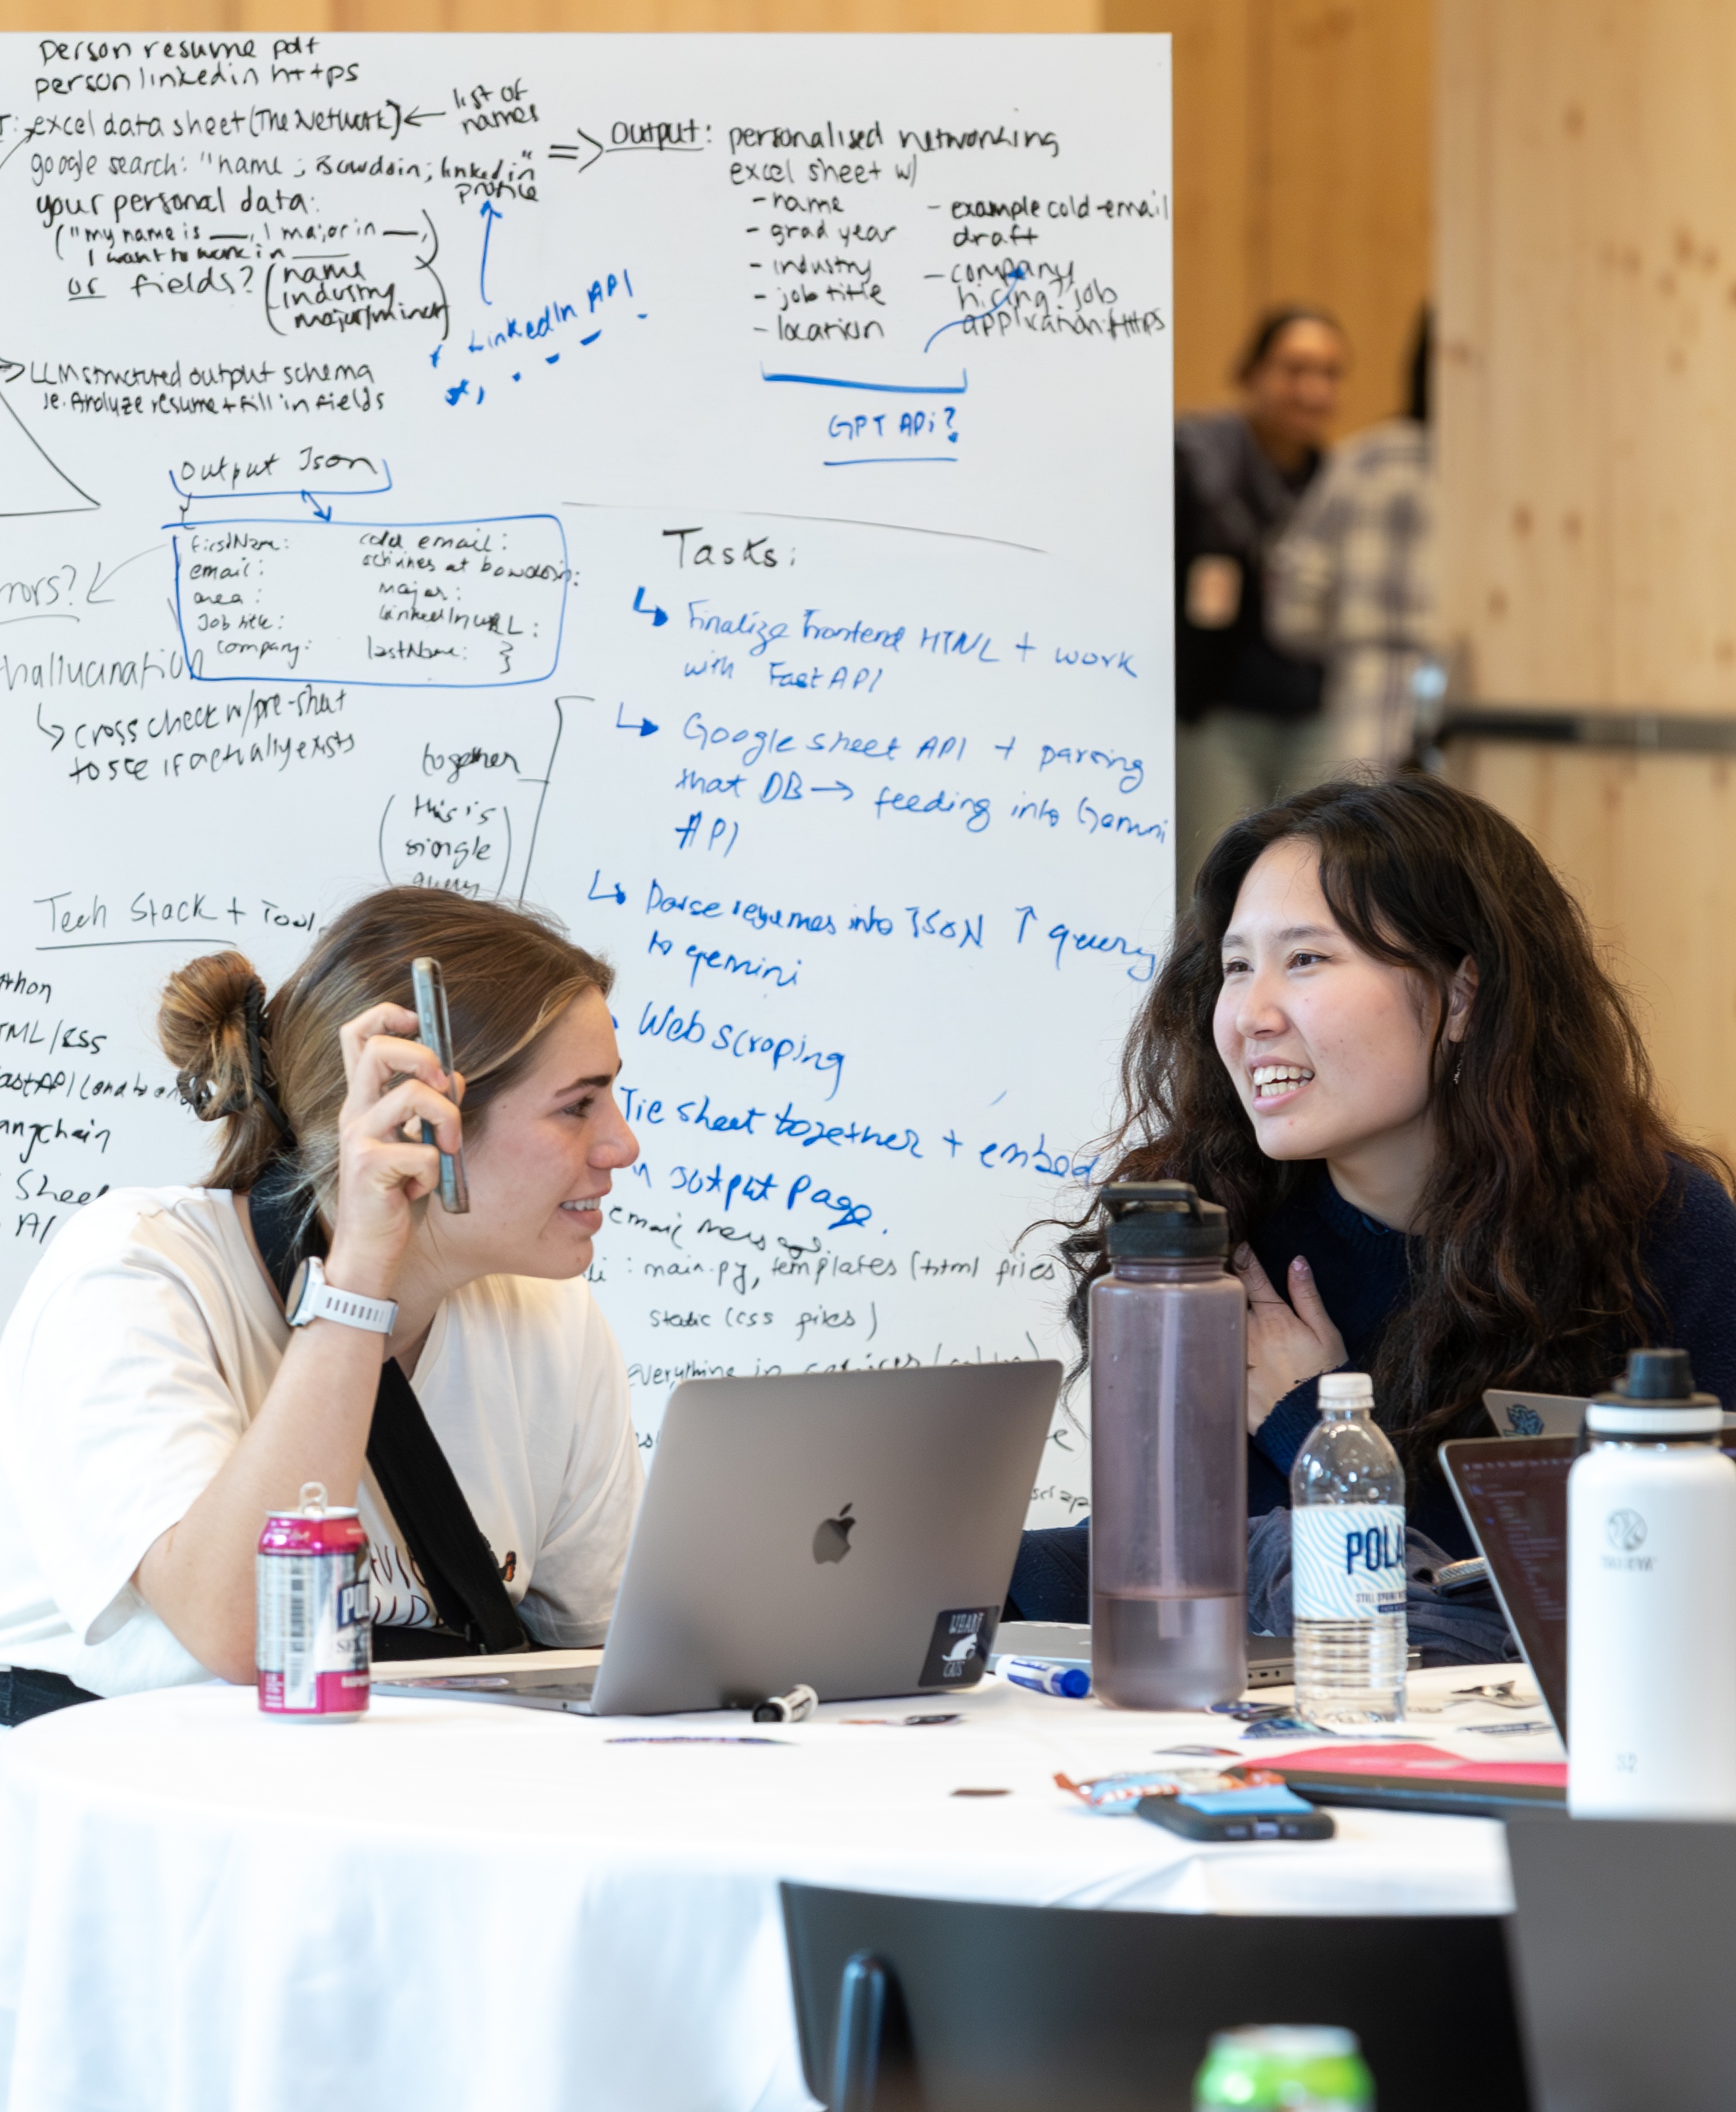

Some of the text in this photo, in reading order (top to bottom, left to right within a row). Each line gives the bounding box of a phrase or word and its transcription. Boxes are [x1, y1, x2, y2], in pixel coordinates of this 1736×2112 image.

[144, 38, 256, 59] resume
[35, 72, 131, 101] person
[453, 77, 529, 110] list of
[33, 109, 95, 136] excel
[462, 104, 540, 135] names
[611, 118, 1059, 158] Output: personalised networking
[31, 150, 97, 187] google
[108, 146, 188, 178] search:
[730, 159, 795, 185] excel
[809, 158, 883, 183] sheet
[37, 185, 320, 229] your personal data:
[773, 192, 845, 214] name
[950, 196, 1040, 222] example
[123, 218, 377, 244] name is major in
[771, 220, 898, 247] grad year
[953, 225, 1039, 248] draft
[106, 249, 168, 265] want
[171, 248, 189, 263] to
[197, 244, 251, 262] work
[256, 244, 285, 260] in
[773, 254, 872, 284] industry
[68, 265, 255, 298] or fields?
[779, 284, 888, 312] job title
[776, 315, 885, 342] location
[189, 361, 276, 390] output
[283, 361, 375, 385] schema
[151, 393, 219, 415] resume
[240, 391, 273, 413] fill
[279, 392, 310, 413] in
[315, 386, 385, 413] fields
[827, 413, 887, 441] GPT
[661, 526, 797, 569] Tasks:
[688, 598, 790, 657] Finalize
[1054, 646, 1138, 679] work
[683, 649, 735, 679] with
[74, 703, 220, 750] cross check
[682, 711, 798, 767] Google
[805, 729, 902, 761] sheet
[915, 735, 967, 762] API
[466, 801, 498, 825] is
[674, 768, 748, 797] that
[758, 769, 805, 804] DB
[874, 786, 992, 834] feeding
[33, 891, 107, 933] Tech
[130, 891, 219, 928] Stack
[648, 930, 674, 956] to
[638, 1000, 706, 1043] Web
[619, 1086, 666, 1125] Tie
[775, 1101, 924, 1159] together
[0, 1117, 111, 1164] angchain
